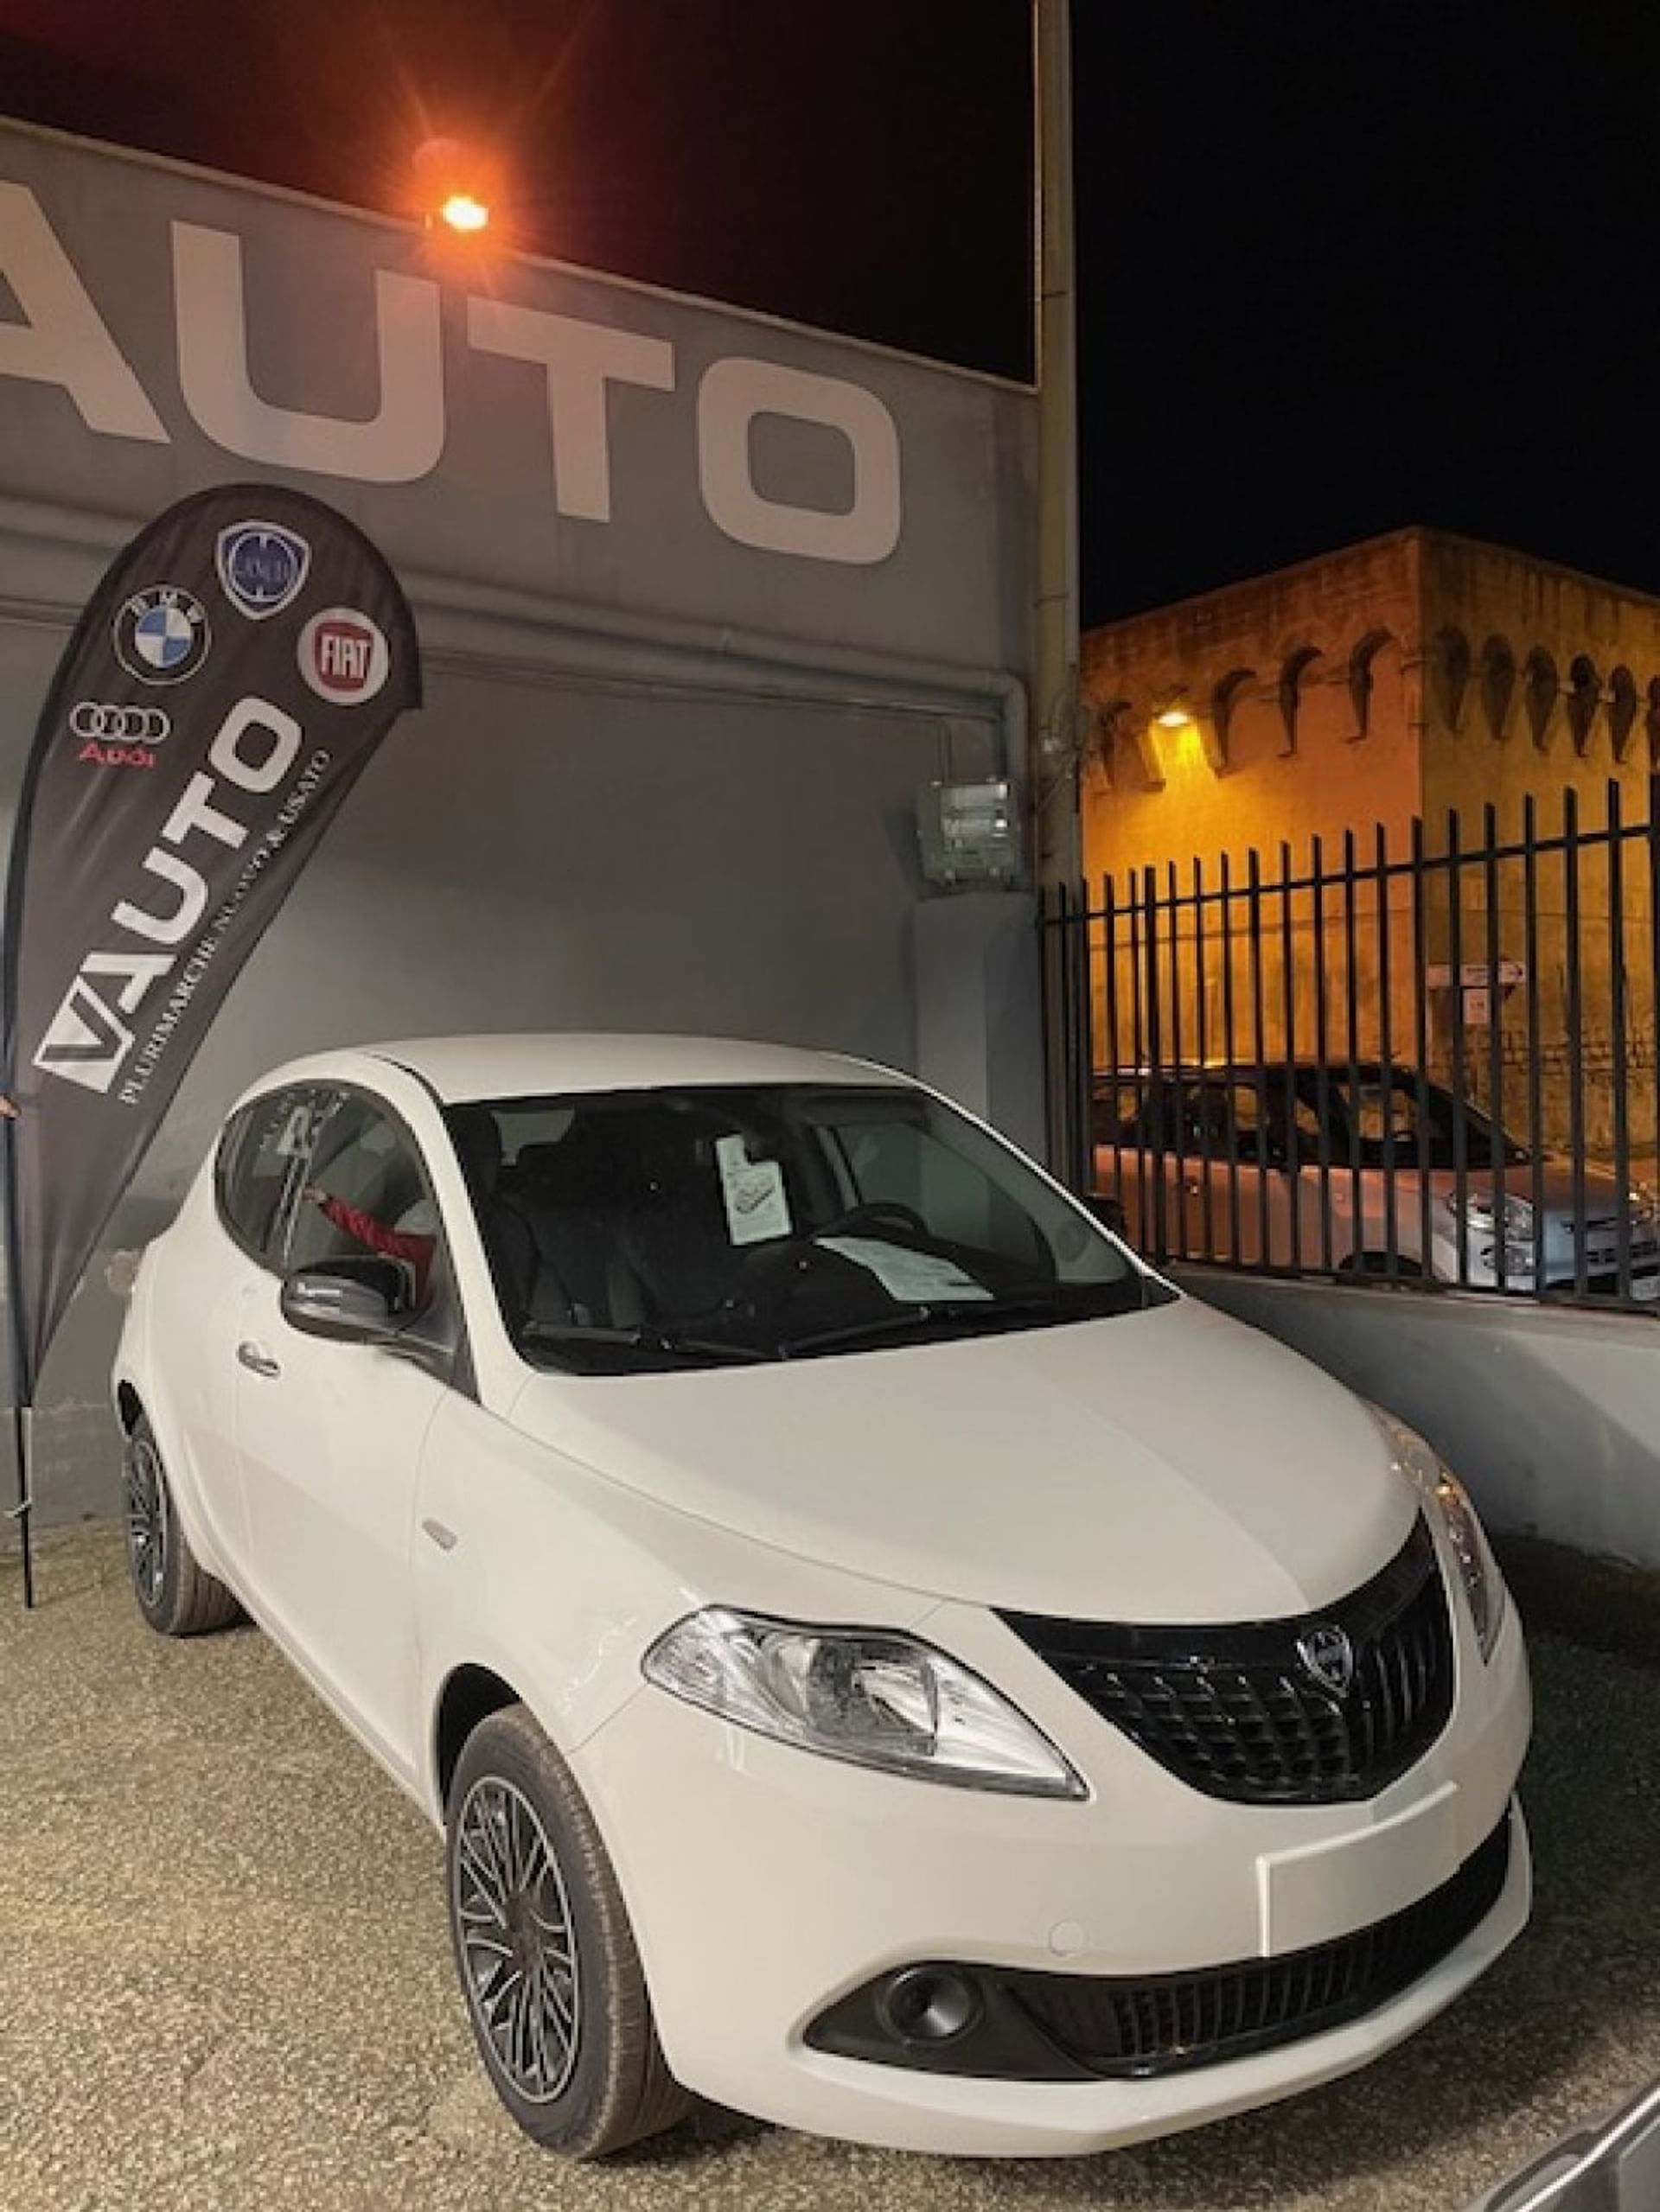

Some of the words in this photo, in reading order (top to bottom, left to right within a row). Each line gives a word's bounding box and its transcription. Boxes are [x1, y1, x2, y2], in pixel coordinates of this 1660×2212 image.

[0, 181, 901, 564] AUTO
[124, 590, 205, 623] BMW
[320, 632, 372, 679] FIAT
[79, 741, 155, 768] Audi
